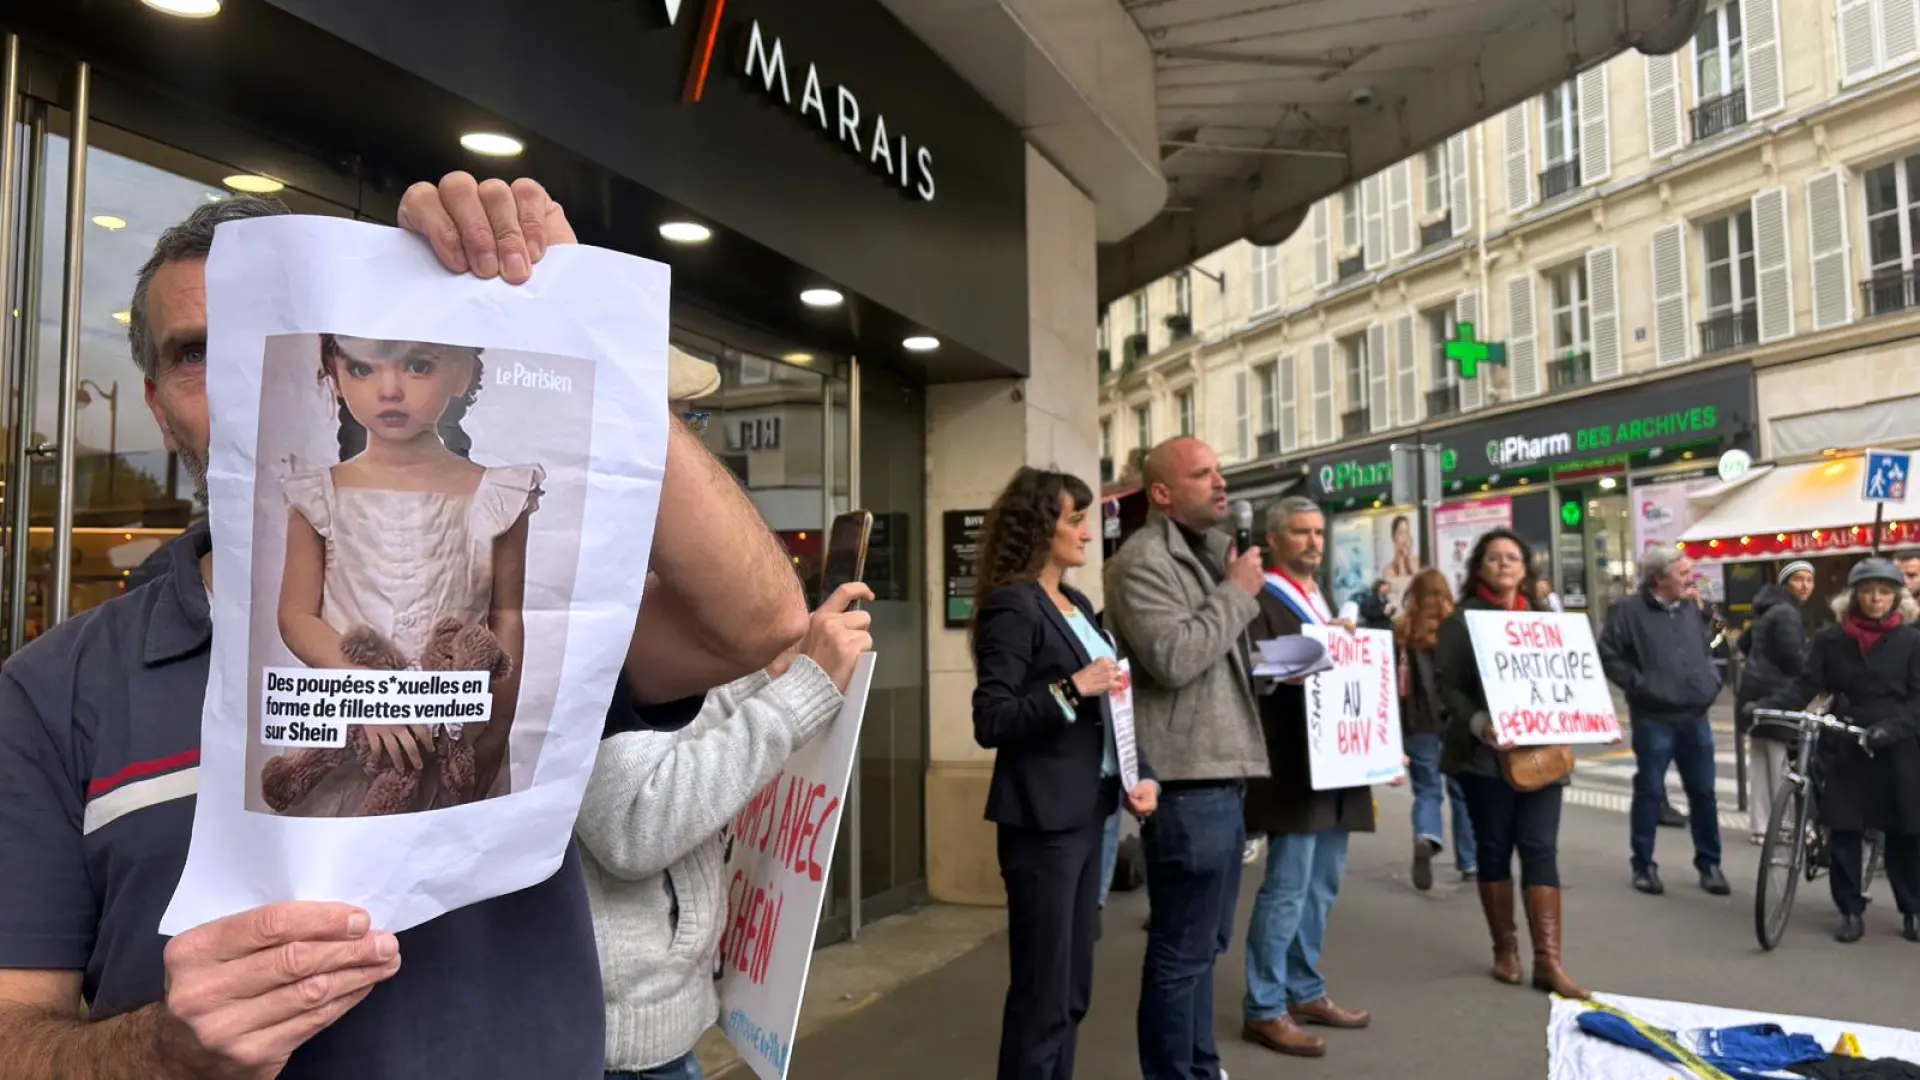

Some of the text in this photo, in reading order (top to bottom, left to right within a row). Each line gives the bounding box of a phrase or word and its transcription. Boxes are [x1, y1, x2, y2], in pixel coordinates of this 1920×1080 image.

[744, 18, 936, 201] MARAIS
[496, 362, 572, 393] Le Parisien
[1500, 431, 1572, 465] iPharm
[1577, 426, 1611, 451] DES
[1616, 405, 1717, 444] ARCHIVES
[1335, 448, 1458, 491] Phare
[1494, 650, 1595, 682] PARTICIPE
[268, 673, 294, 692] Des
[296, 675, 374, 696] poupées
[462, 679, 482, 694] en
[1343, 680, 1361, 717] AU
[1552, 684, 1575, 703] LA
[266, 696, 484, 718] forme de fillettes vendues
[265, 722, 338, 742] sur Shein
[1337, 717, 1372, 755] BHV
[773, 776, 839, 881] AVEC
